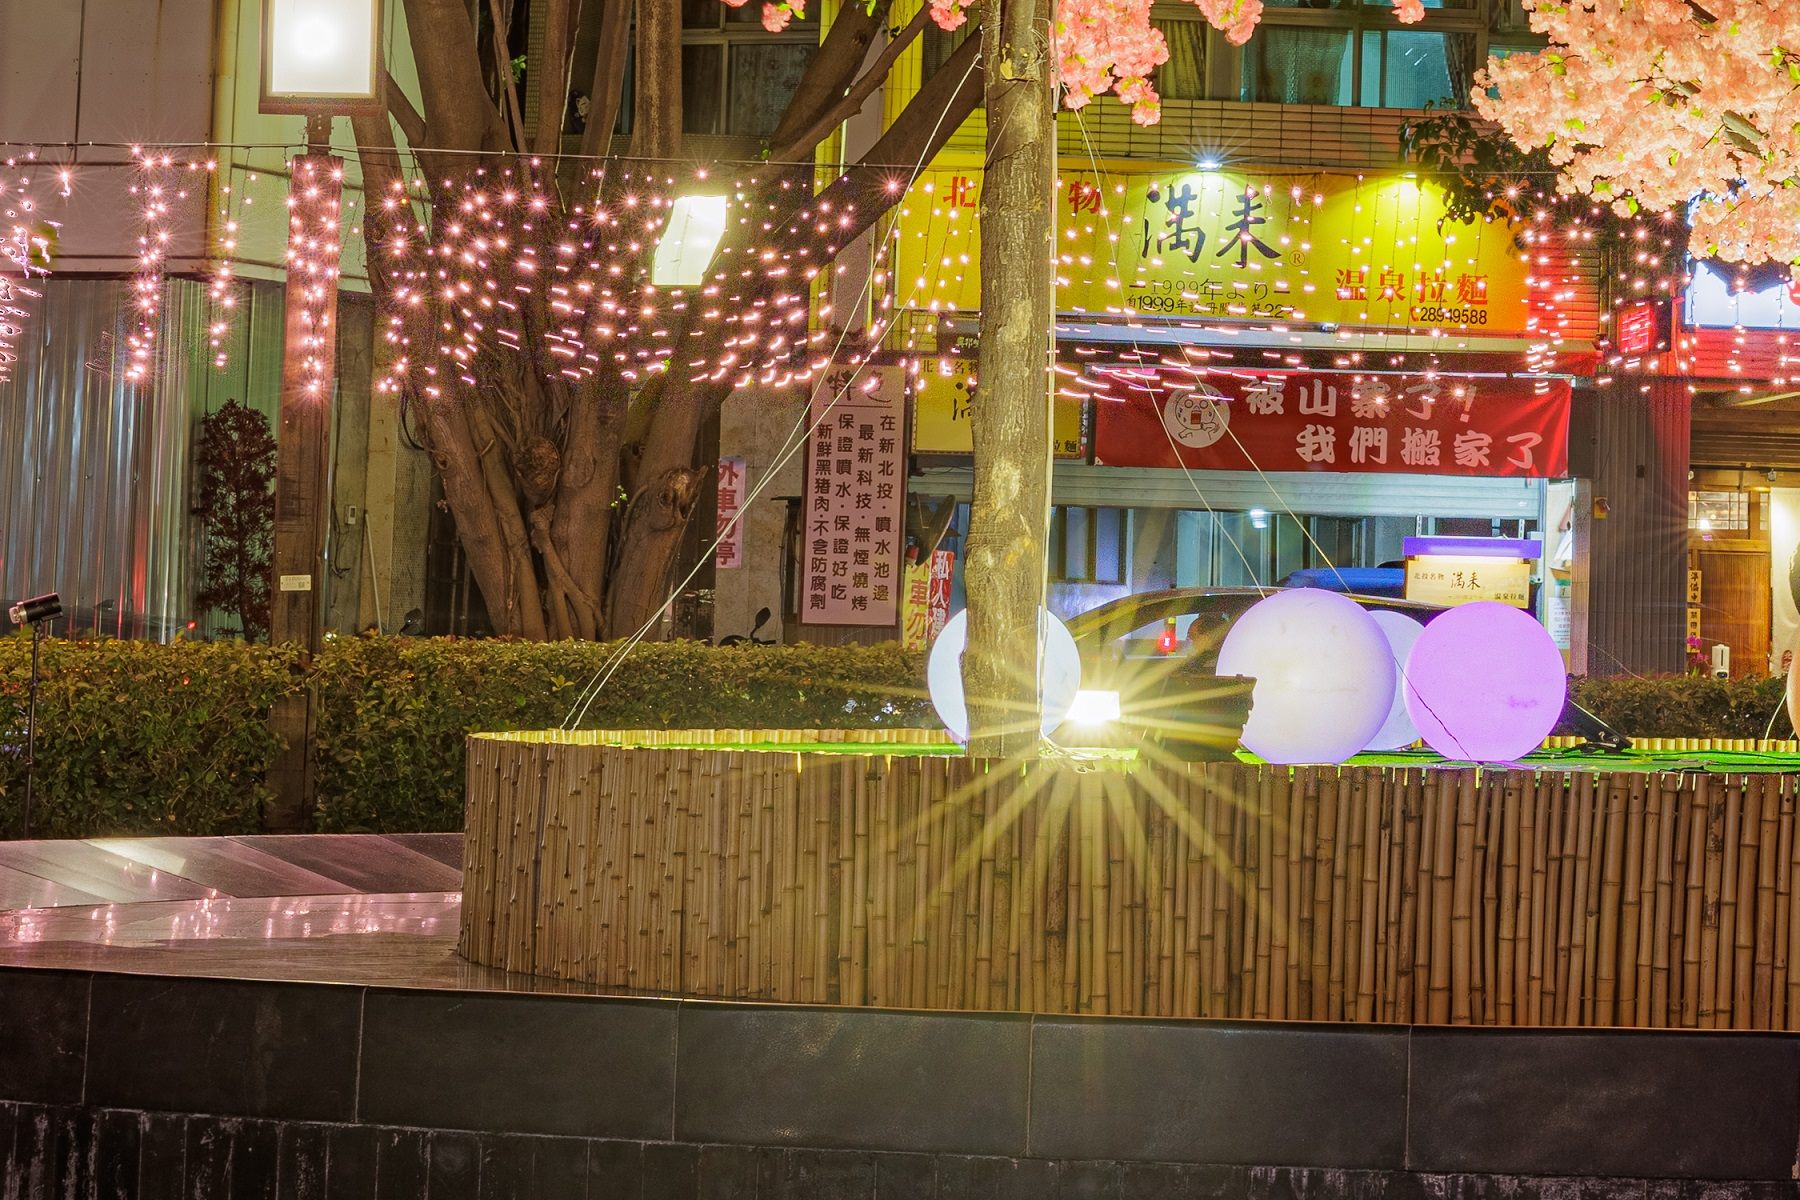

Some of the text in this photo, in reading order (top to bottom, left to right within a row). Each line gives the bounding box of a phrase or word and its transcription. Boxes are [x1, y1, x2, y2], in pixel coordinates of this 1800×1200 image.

[1420, 307, 1488, 325] 28949588
[1296, 423, 1543, 469] 我們搬家了
